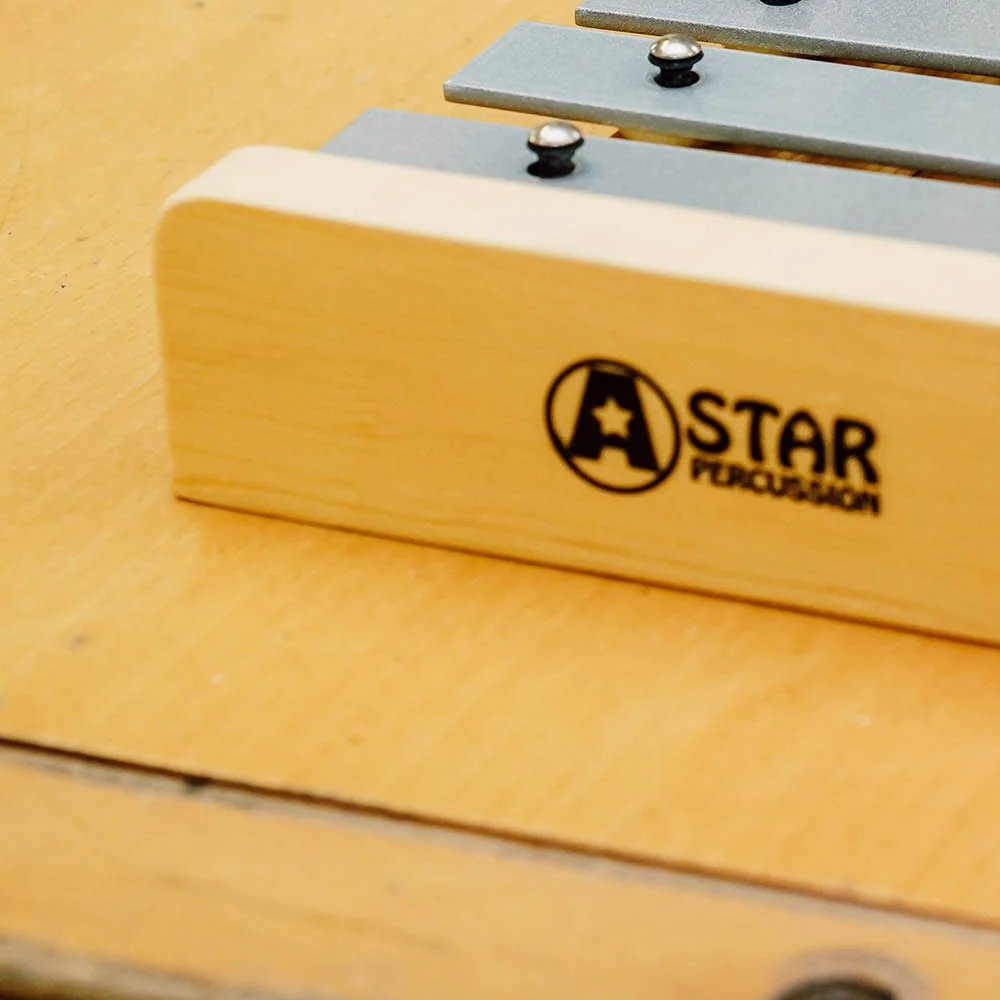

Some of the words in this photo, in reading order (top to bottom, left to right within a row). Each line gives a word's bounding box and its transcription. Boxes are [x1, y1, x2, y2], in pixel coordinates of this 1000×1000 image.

[561, 365, 663, 477] A
[686, 387, 879, 485] STAR
[690, 455, 881, 517] PERCUSSION
